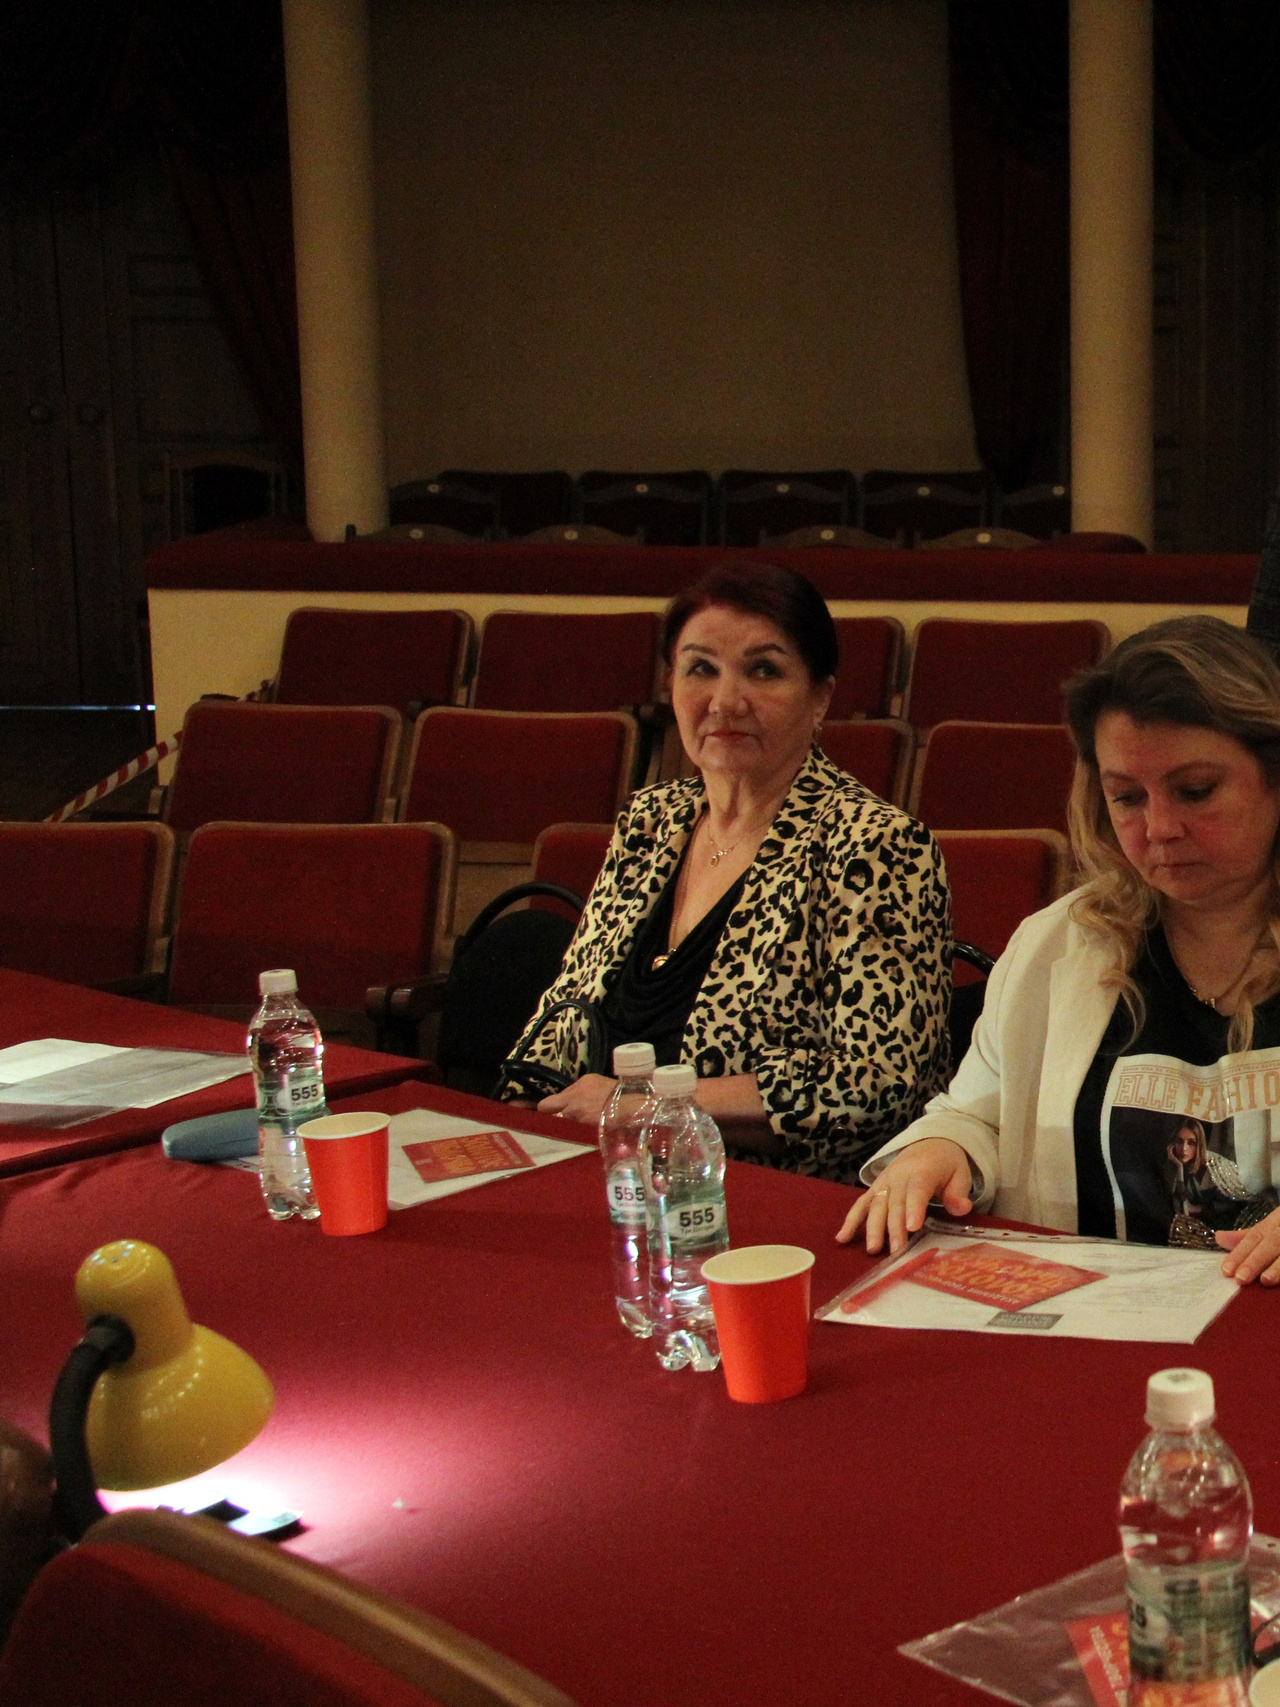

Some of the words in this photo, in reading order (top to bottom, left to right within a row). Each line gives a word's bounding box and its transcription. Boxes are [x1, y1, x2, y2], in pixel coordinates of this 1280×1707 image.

[291, 1083, 319, 1101] 555
[1113, 1073, 1180, 1112] ELLE
[614, 1186, 645, 1201] 555
[680, 1207, 715, 1227] 555
